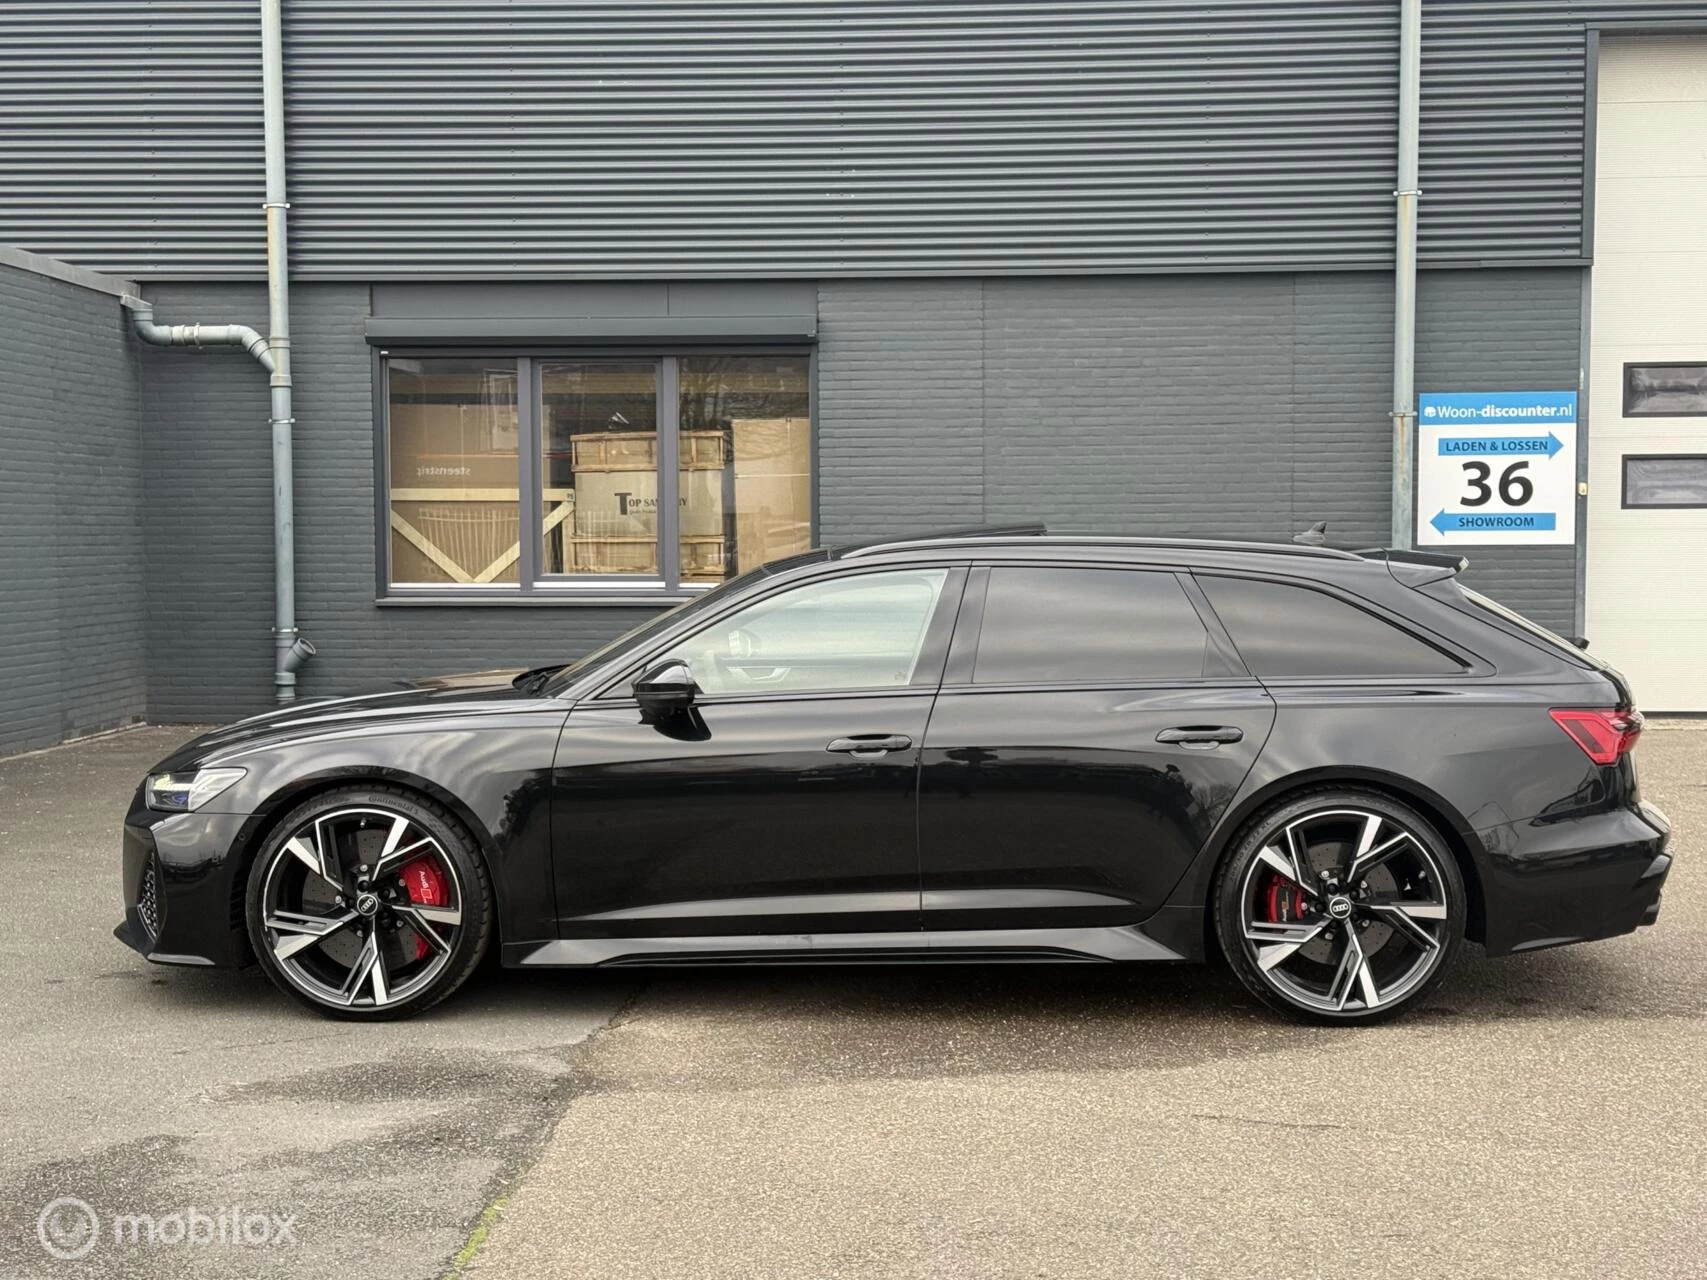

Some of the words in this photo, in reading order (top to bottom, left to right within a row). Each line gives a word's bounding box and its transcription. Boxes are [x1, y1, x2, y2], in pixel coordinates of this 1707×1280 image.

[1436, 403, 1573, 418] Woon-discounter.nl
[1446, 442, 1487, 452] LADEN
[1489, 441, 1499, 451] &
[1501, 440, 1549, 451] LOSSEN
[1460, 460, 1534, 507] 36
[1458, 517, 1535, 527] SHOWROOM
